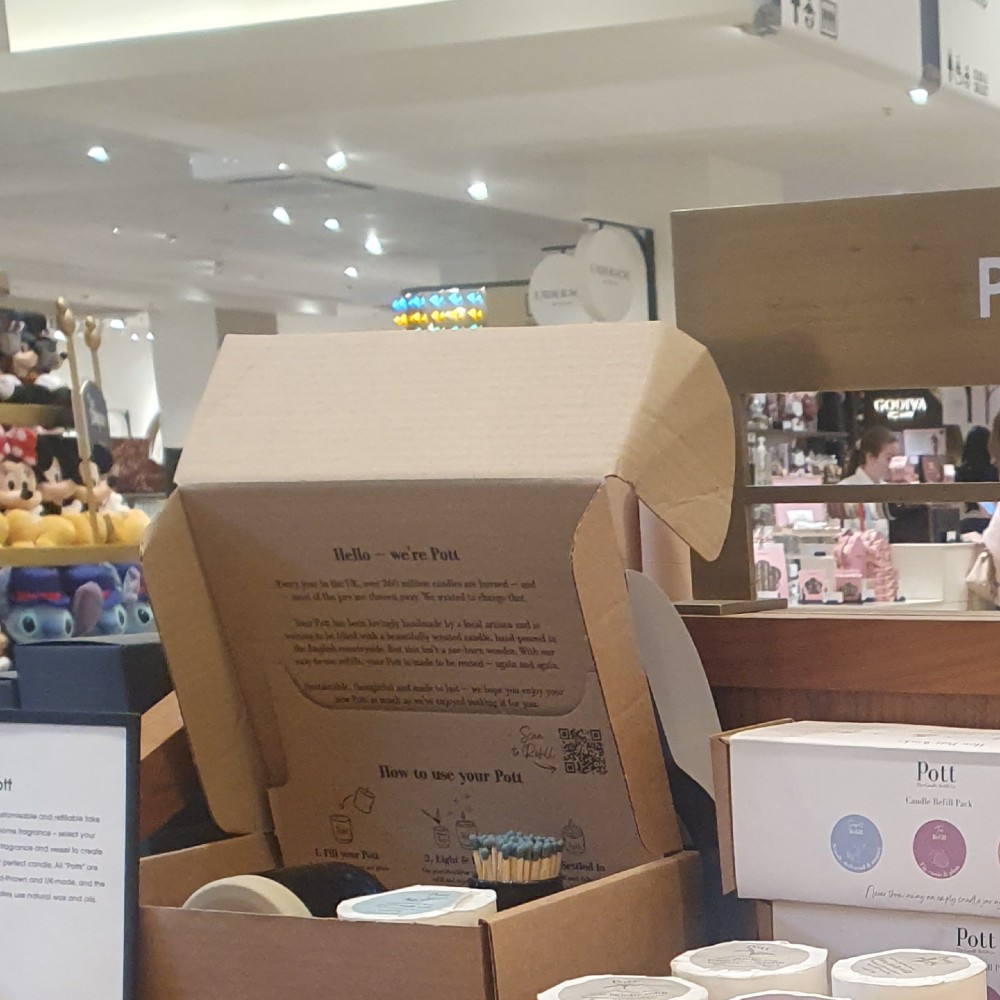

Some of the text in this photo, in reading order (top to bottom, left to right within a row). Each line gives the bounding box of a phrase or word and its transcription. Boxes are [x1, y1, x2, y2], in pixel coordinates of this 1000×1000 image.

[874, 397, 928, 412] GODIVA
[333, 545, 460, 561] Hello we're Pott
[378, 764, 523, 785] How to use your Pott
[917, 761, 956, 783] Pott
[905, 797, 973, 808] Candle Refill Pack
[956, 927, 996, 949] Pott
